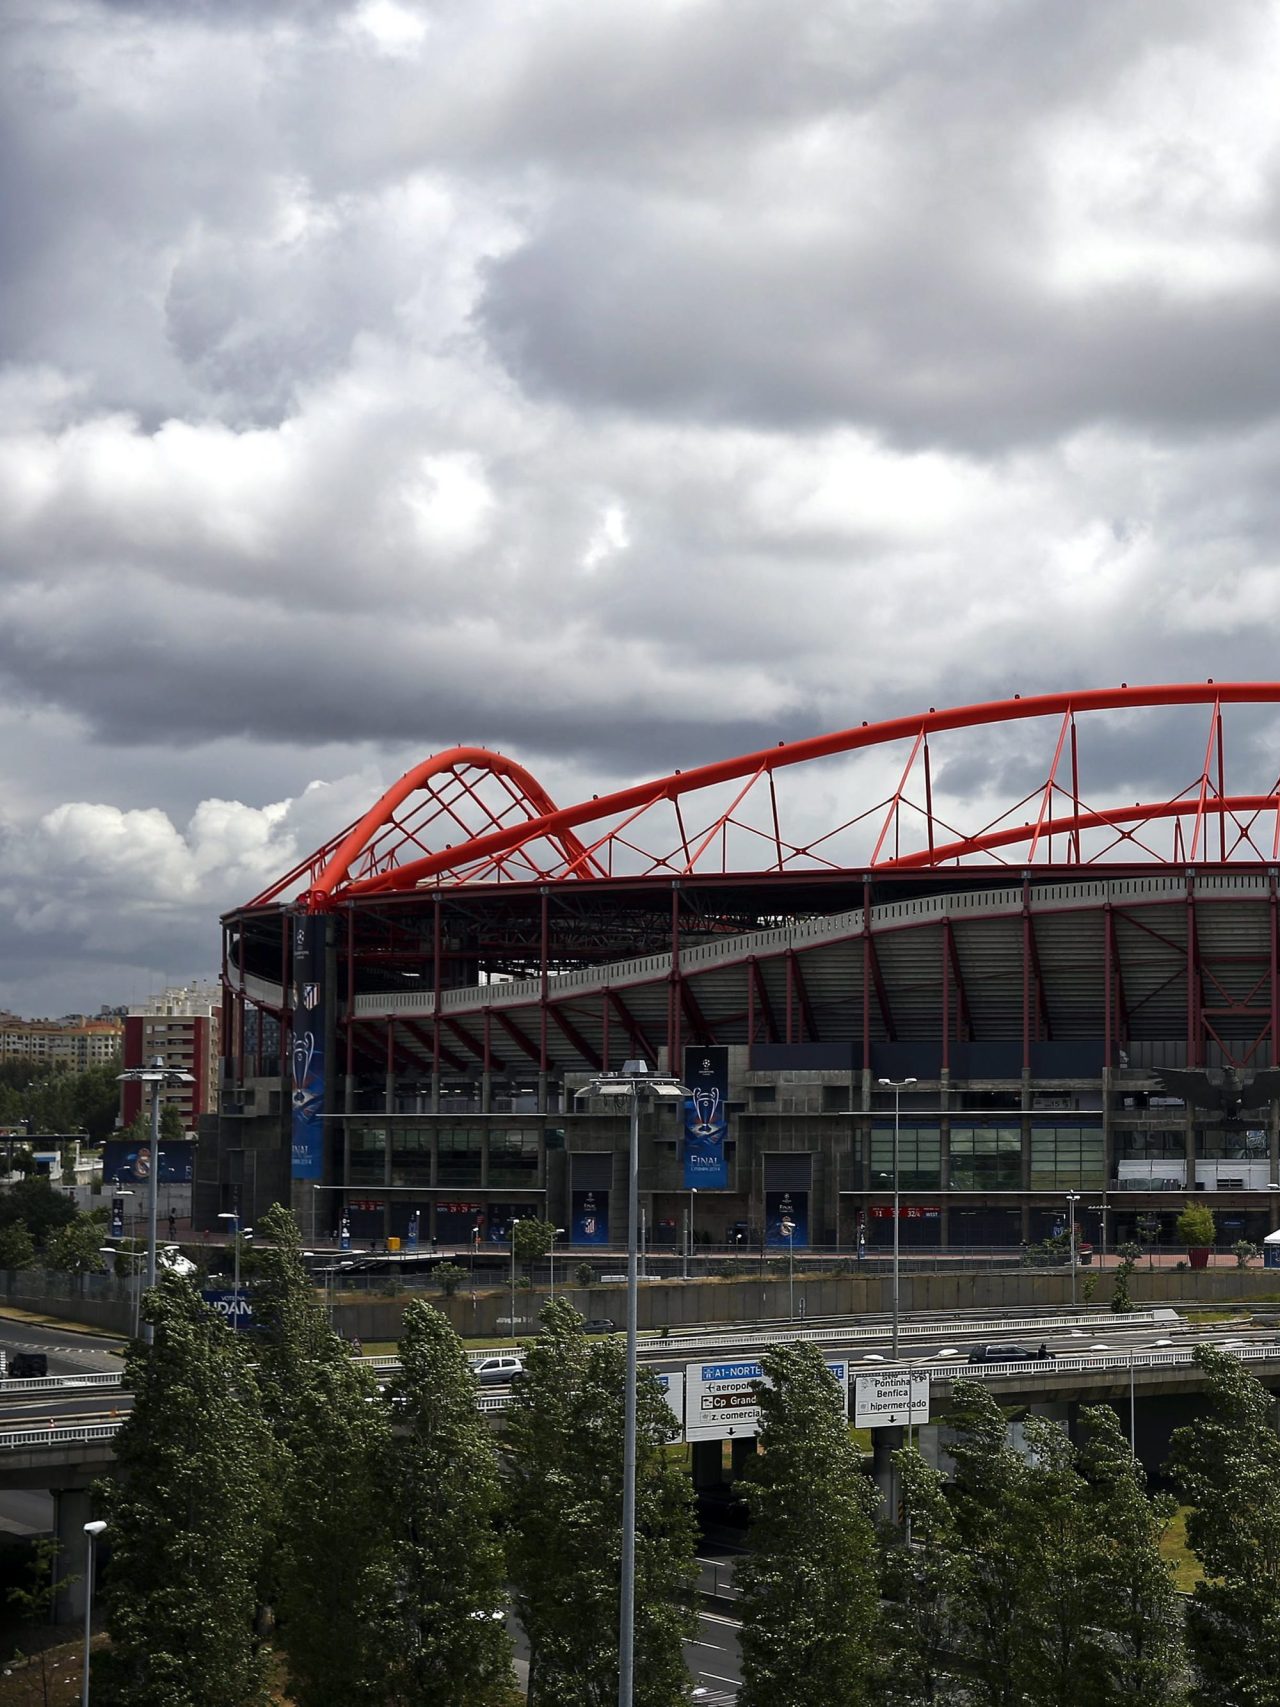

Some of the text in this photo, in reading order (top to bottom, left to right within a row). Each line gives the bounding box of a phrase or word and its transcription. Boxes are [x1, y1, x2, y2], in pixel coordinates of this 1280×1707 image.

[690, 1154, 718, 1165] FINAL
[715, 1366, 762, 1378] A1-NORTE
[715, 1382, 750, 1392] aeropor
[875, 1379, 911, 1388] Pontinha
[877, 1389, 909, 1398] Benfica
[730, 1395, 757, 1405] Grand
[870, 1400, 927, 1411] hipermercado
